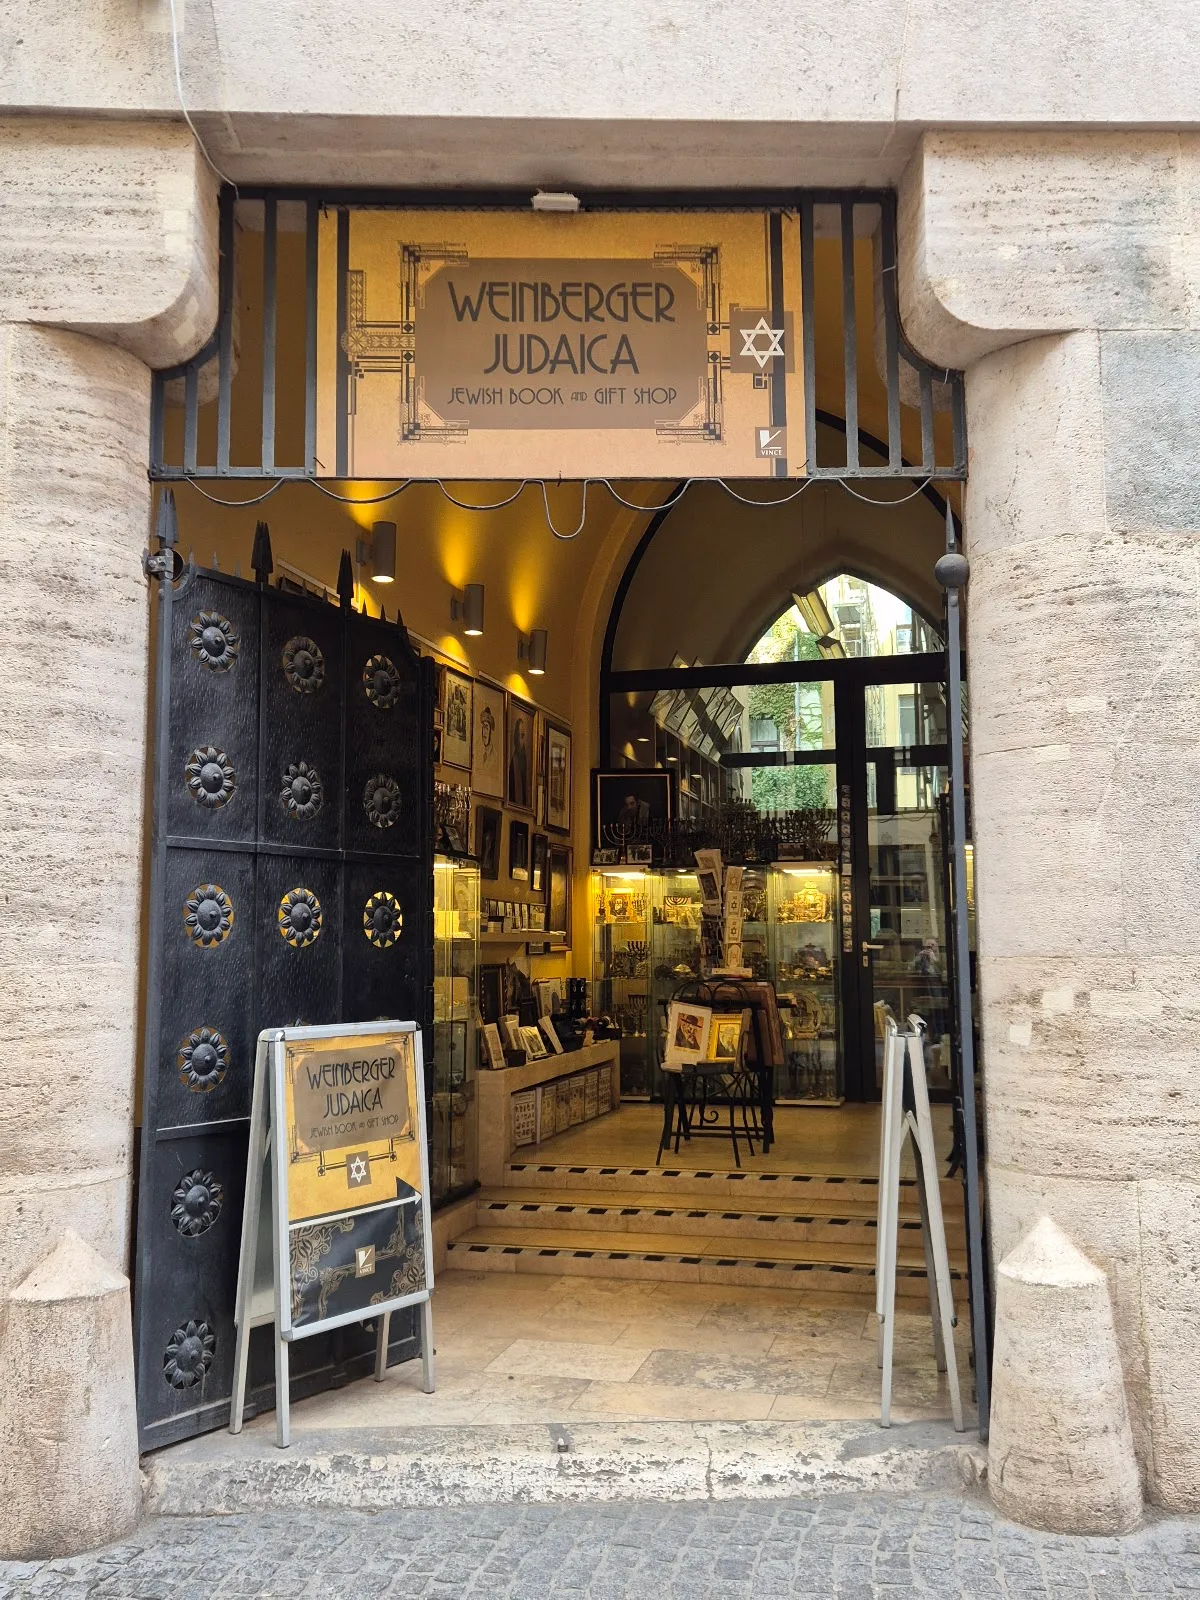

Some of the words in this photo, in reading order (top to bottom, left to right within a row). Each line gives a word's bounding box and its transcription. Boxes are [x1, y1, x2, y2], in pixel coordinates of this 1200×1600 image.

[447, 281, 676, 323] WEINBERGER
[483, 333, 640, 375] JUDAICA
[447, 387, 503, 405] JEWISH
[509, 387, 564, 405] BOOK
[570, 391, 588, 402] AND
[594, 387, 626, 405] GIFT
[633, 387, 677, 405] SHOP
[306, 1057, 395, 1089] WEINBERGER
[323, 1087, 383, 1118] JUDAICA
[310, 1125, 334, 1140] JEWISH
[334, 1121, 357, 1135] BOOK
[381, 1114, 399, 1126] SHOP
